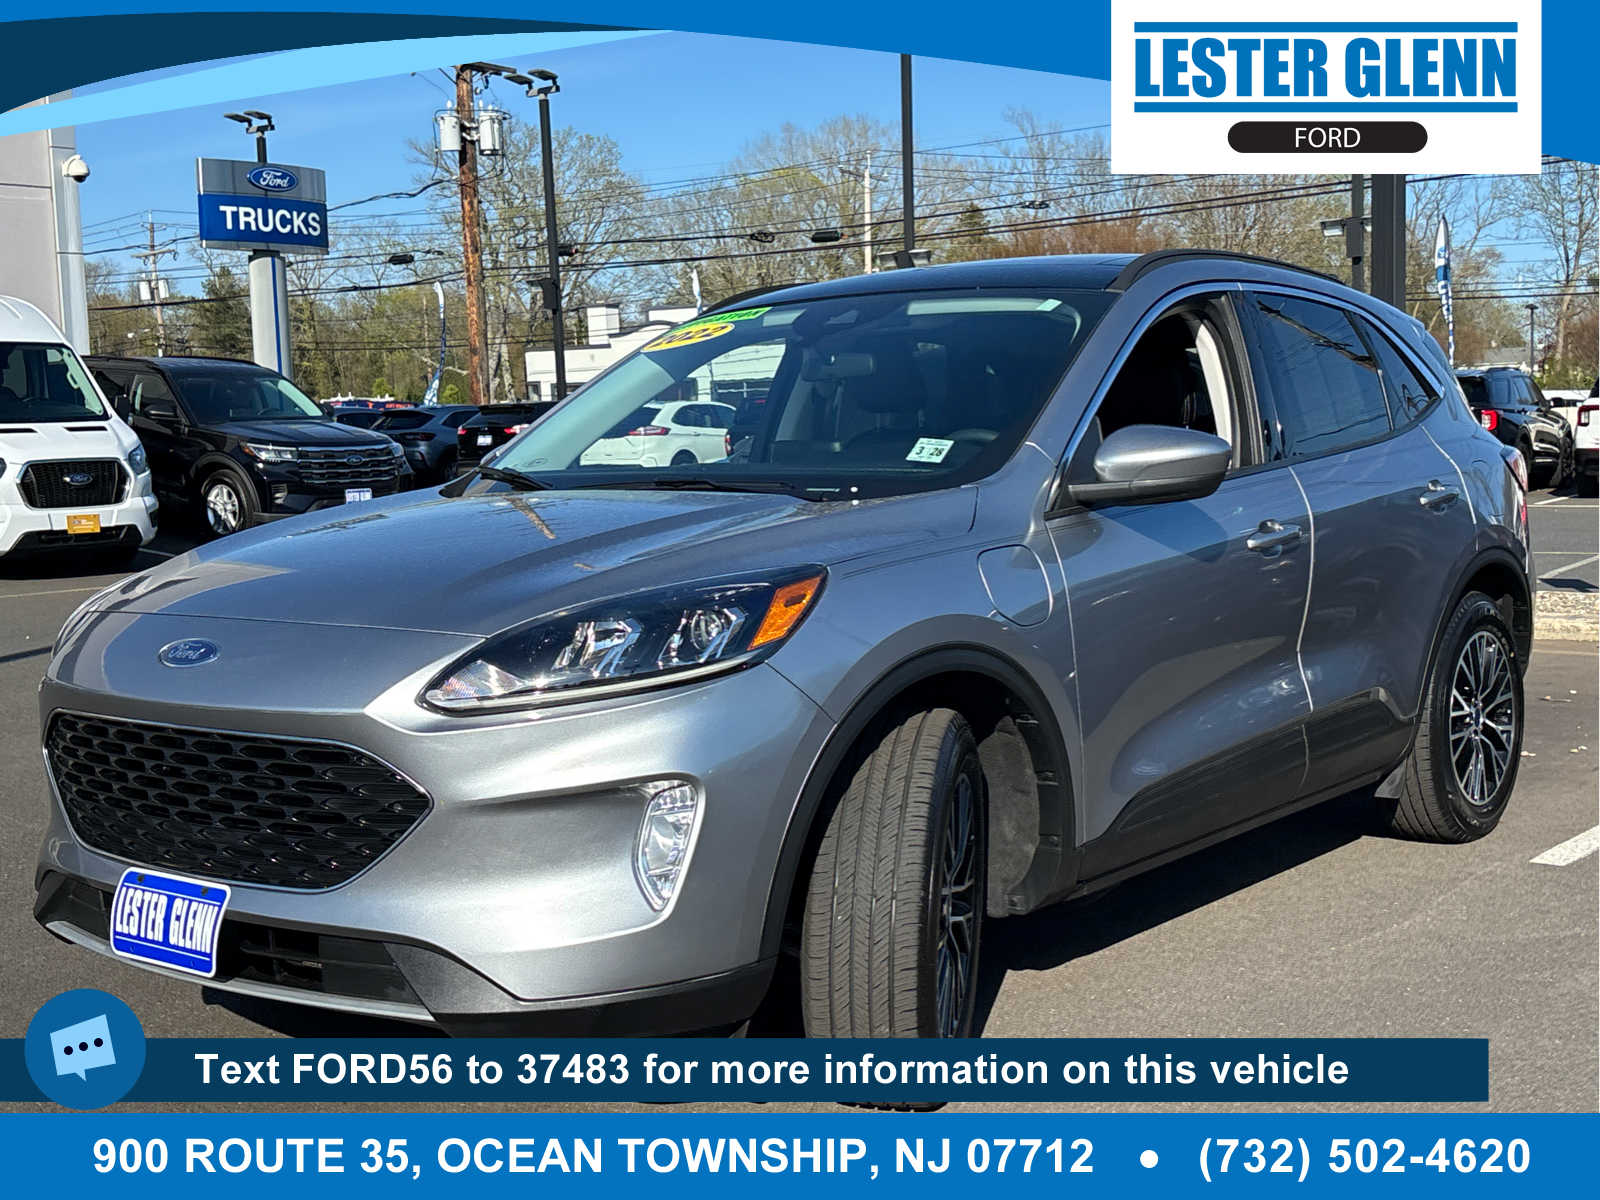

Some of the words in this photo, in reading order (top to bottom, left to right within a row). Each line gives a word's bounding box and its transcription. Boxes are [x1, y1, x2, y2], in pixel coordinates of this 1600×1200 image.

[260, 170, 290, 188] Ford
[219, 204, 321, 236] TRUCKS
[169, 642, 207, 660] Ford
[115, 886, 168, 943] LESTER
[169, 897, 219, 954] GLENN
